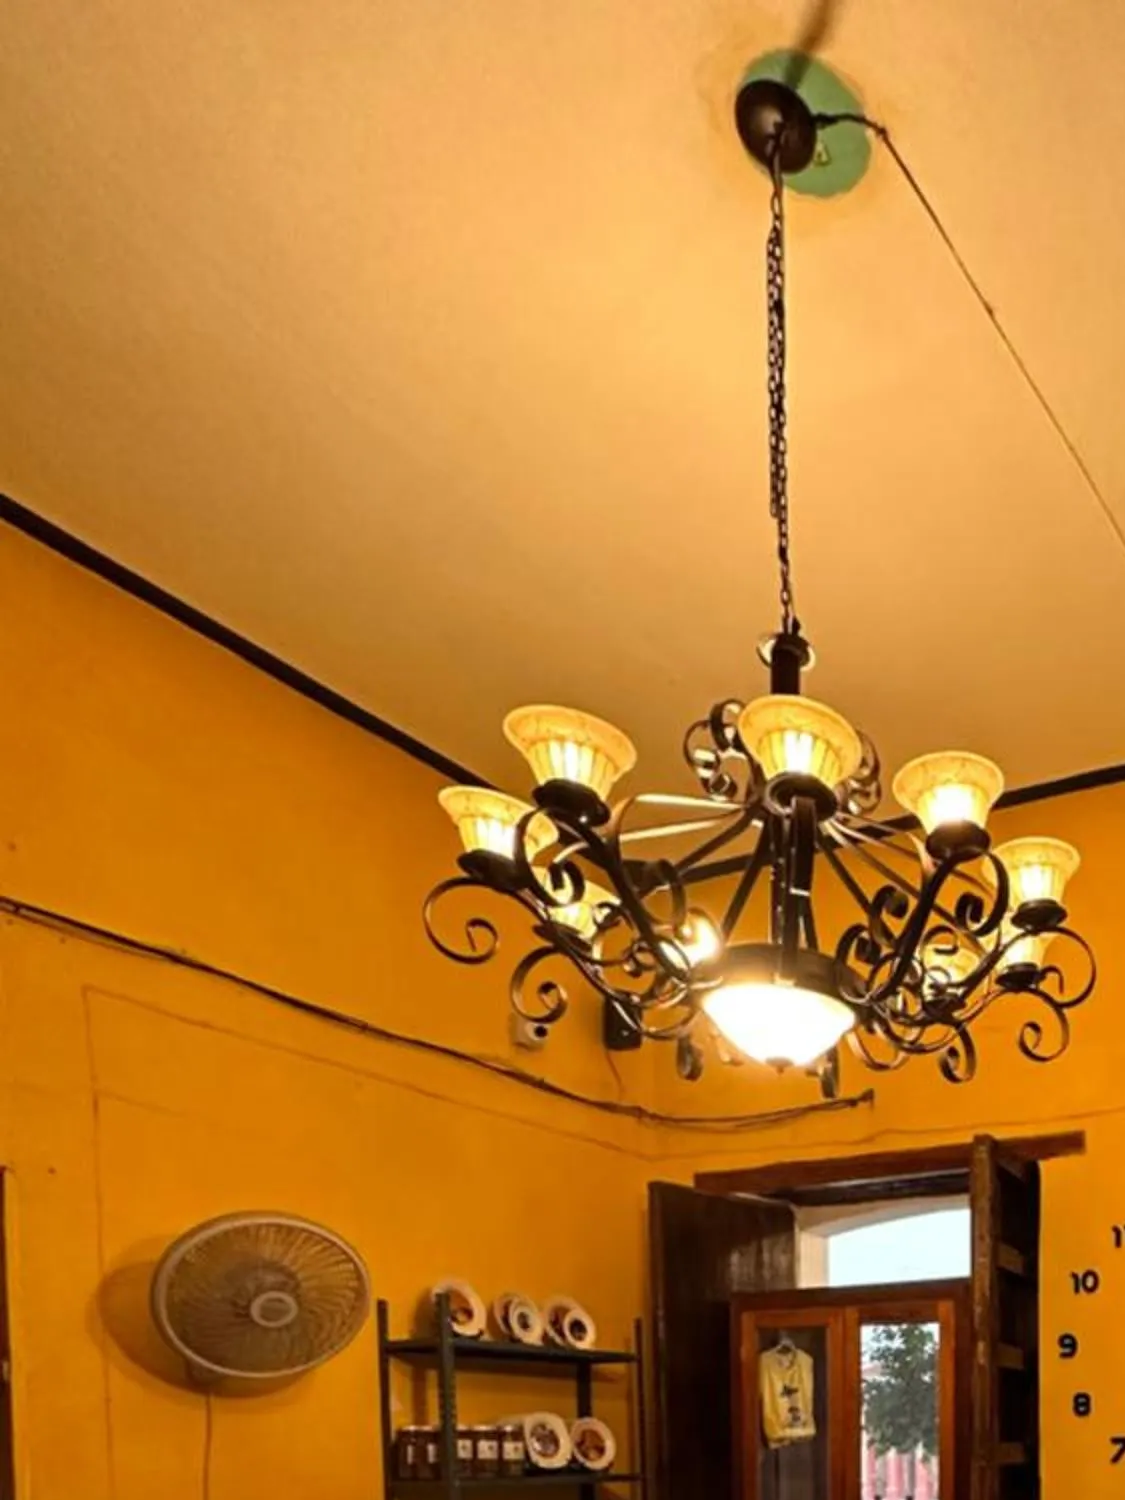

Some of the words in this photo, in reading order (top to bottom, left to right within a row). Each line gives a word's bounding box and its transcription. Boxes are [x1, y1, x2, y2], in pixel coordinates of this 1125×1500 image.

[1070, 1269, 1100, 1295] 10
[1057, 1332, 1079, 1360] 9
[1071, 1391, 1092, 1419] 8
